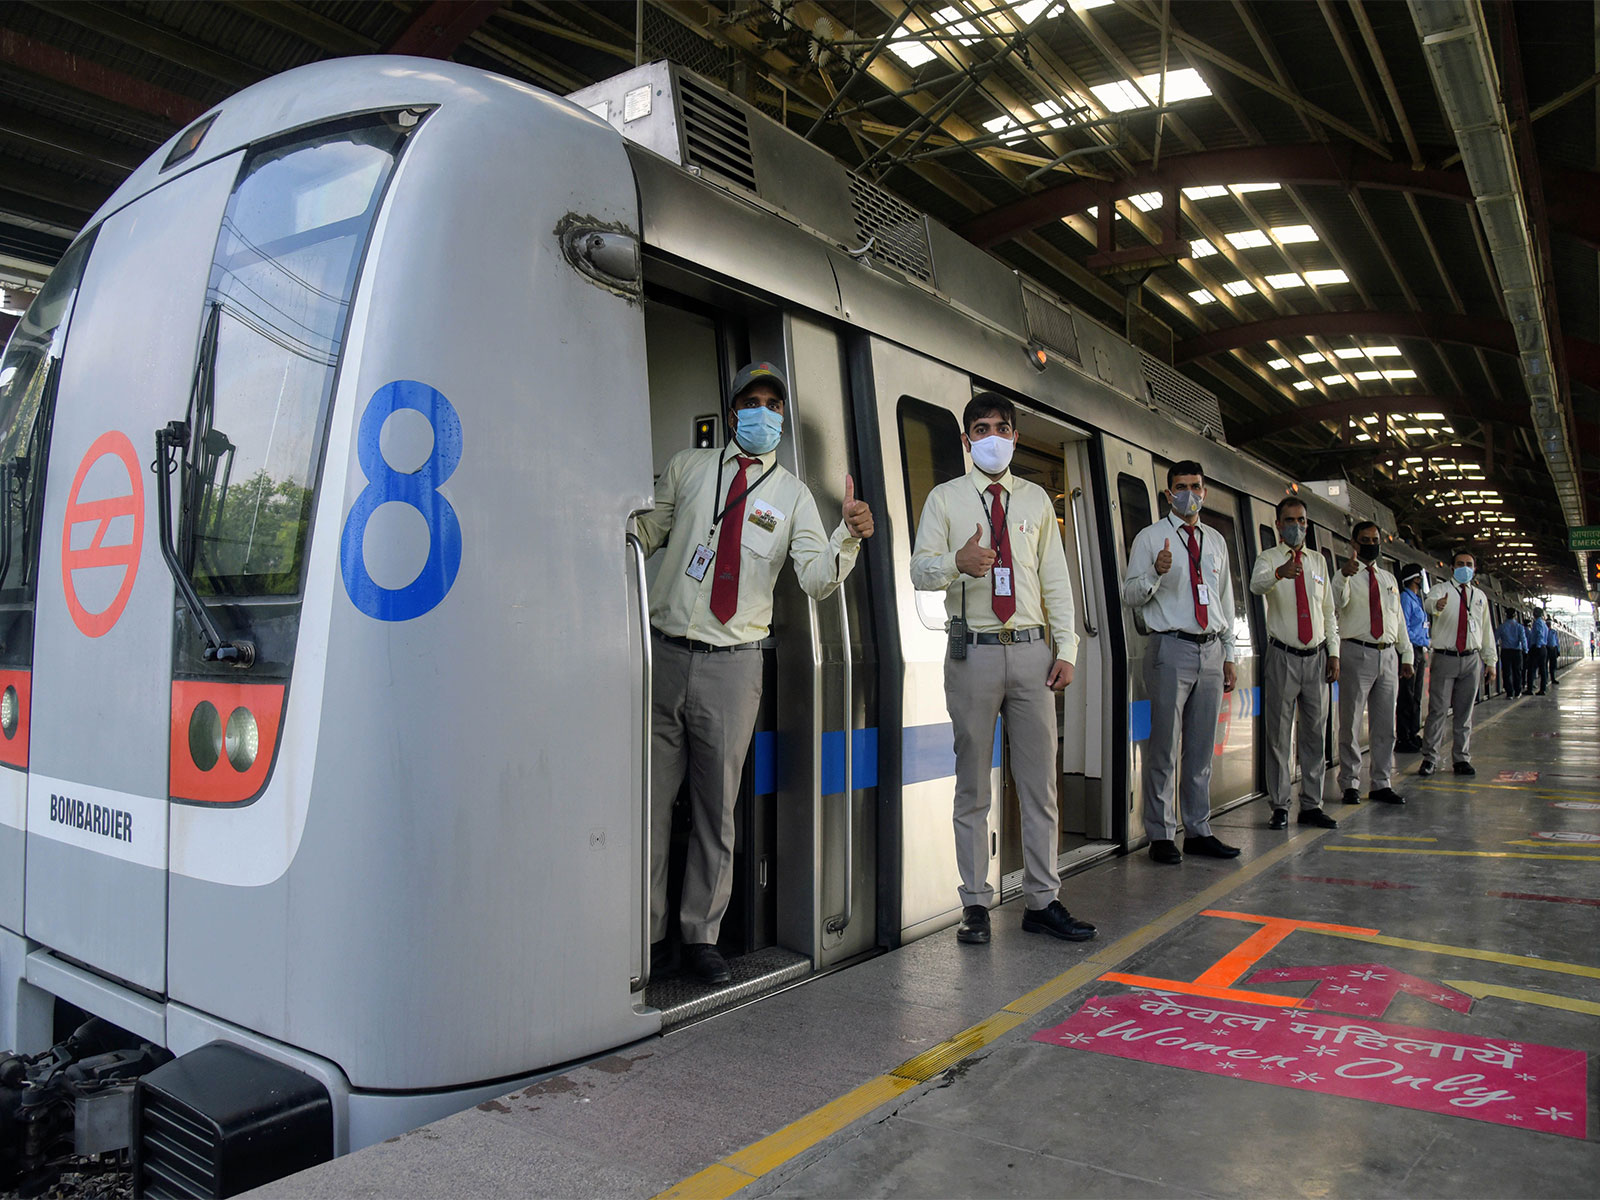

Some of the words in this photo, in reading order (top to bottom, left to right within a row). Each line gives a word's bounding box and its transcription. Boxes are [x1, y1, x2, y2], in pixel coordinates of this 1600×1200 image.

[340, 379, 463, 622] 8
[50, 793, 132, 843] BOMBARDIER
[1140, 997, 1276, 1032] केवल
[1096, 1019, 1299, 1068] Women
[1334, 1057, 1516, 1108] Only
